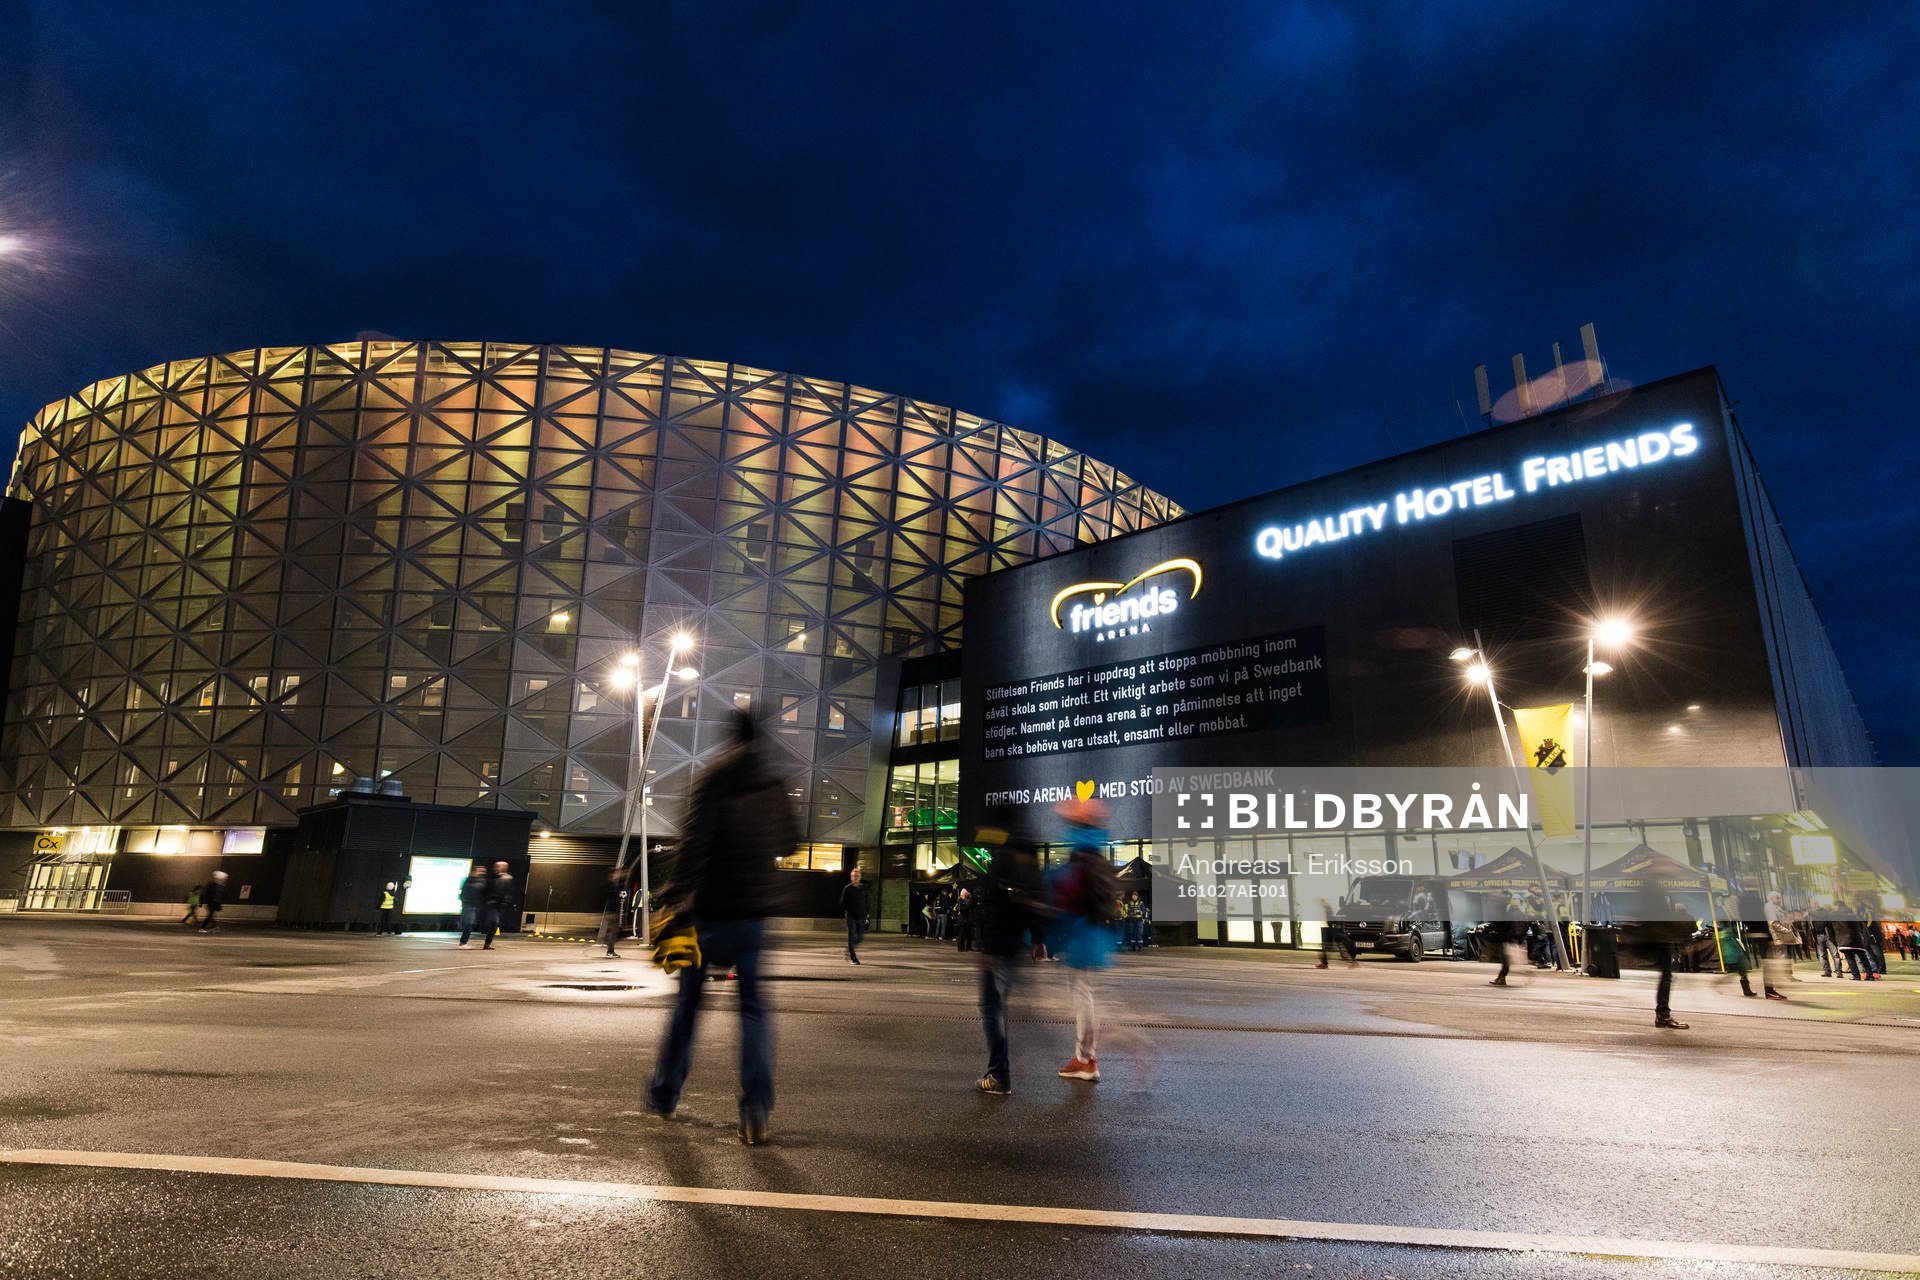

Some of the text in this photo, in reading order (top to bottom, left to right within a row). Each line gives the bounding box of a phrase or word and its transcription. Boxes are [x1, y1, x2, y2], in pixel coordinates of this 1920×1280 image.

[1255, 423, 1699, 559] QUALITY HOTEL FRIENDS
[1070, 586, 1179, 633] friends
[1097, 623, 1152, 642] ARENA
[985, 655, 1322, 720] såväl skola som idrott. Ett viktigt arbete som vi på Swedbank
[986, 638, 1297, 701] Stiftelsen Friends har i uppdrag att stoppa mobbning inom
[985, 682, 1303, 740] stödjer. Namnet på denna arena är en påminnelse att inget
[985, 714, 1248, 759] barn ska behöva vara utsatt, ensamt eller mobbat.
[985, 769, 1275, 807] FRIENDS ARENA MED STÖD AV SWEDBANK
[37, 837, 59, 849] Cx
[1483, 879, 1511, 887] OFFICIAL
[1511, 879, 1559, 887] MERCISE
[1655, 880, 1701, 888] RCHANDISE
